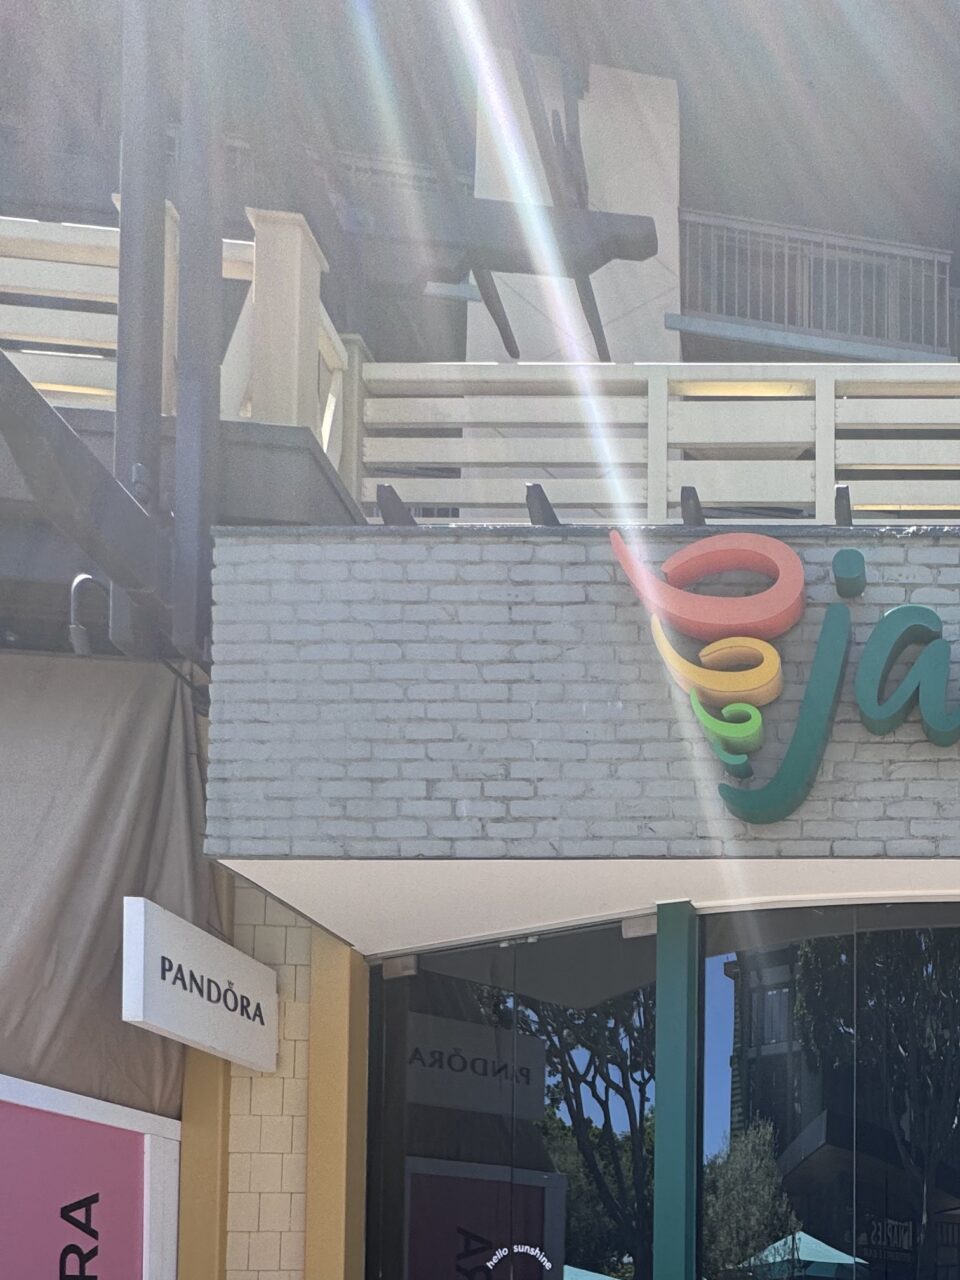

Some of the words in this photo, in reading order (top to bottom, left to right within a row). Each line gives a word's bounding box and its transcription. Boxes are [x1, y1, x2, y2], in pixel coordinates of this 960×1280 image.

[160, 955, 265, 1026] PANDORA
[486, 1247, 509, 1269] hello
[513, 1244, 553, 1271] sunshine
